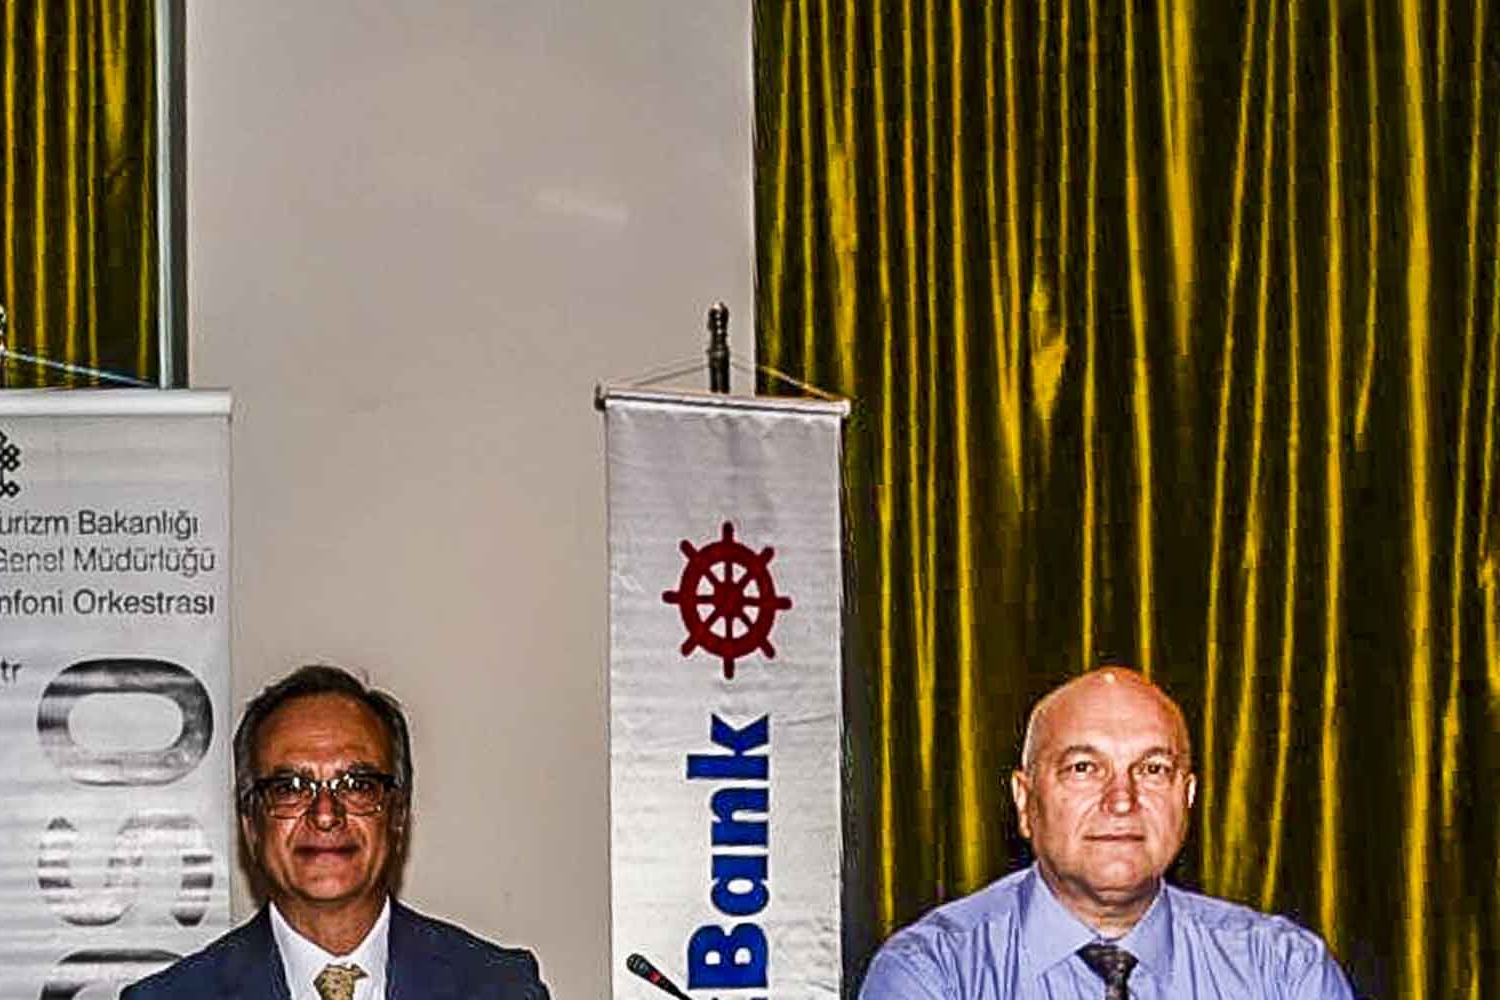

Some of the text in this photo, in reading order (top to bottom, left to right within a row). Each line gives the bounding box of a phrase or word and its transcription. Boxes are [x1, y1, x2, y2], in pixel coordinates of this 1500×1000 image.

[77, 510, 199, 541] Bakanlığı
[73, 546, 215, 578] Müdürlüğü
[73, 588, 214, 615] Orkestrası
